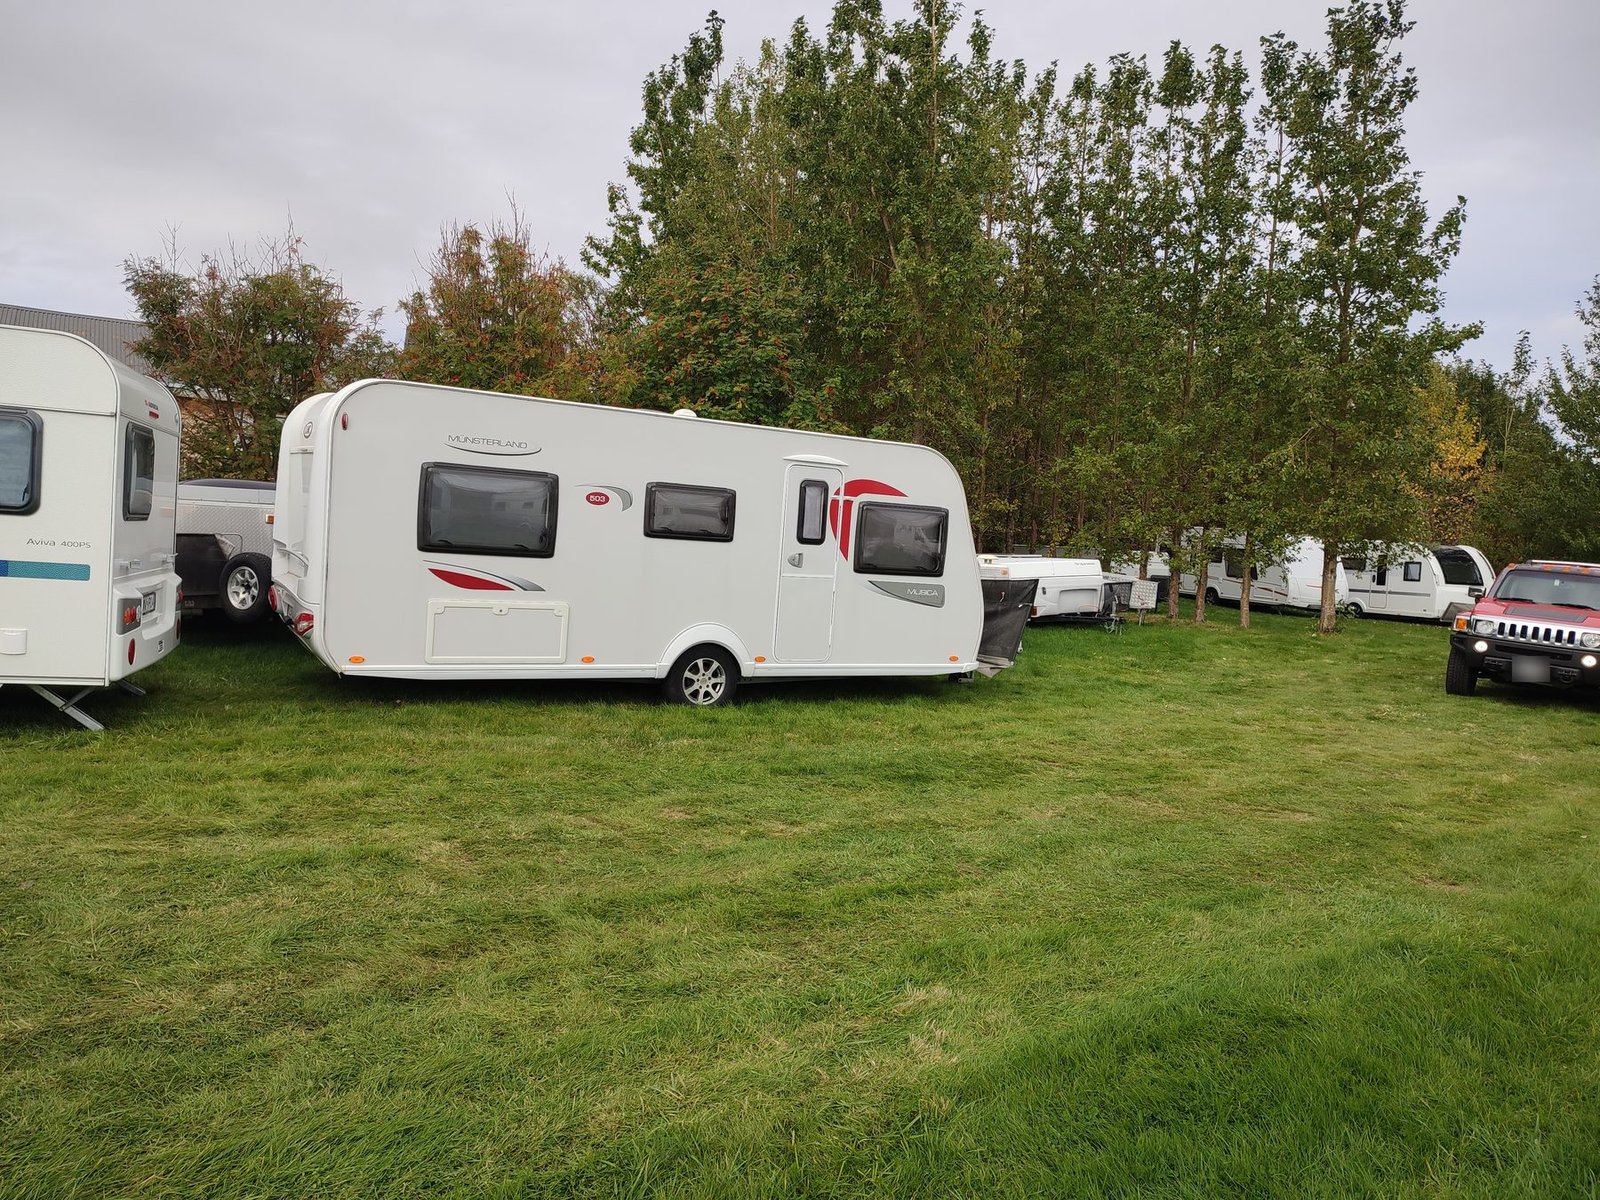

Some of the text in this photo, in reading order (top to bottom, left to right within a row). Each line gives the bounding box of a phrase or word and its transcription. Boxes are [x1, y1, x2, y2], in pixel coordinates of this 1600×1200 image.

[448, 434, 528, 449] MÜNSTERLAND
[590, 494, 606, 503] 503
[26, 538, 92, 549] Aviva 400PS
